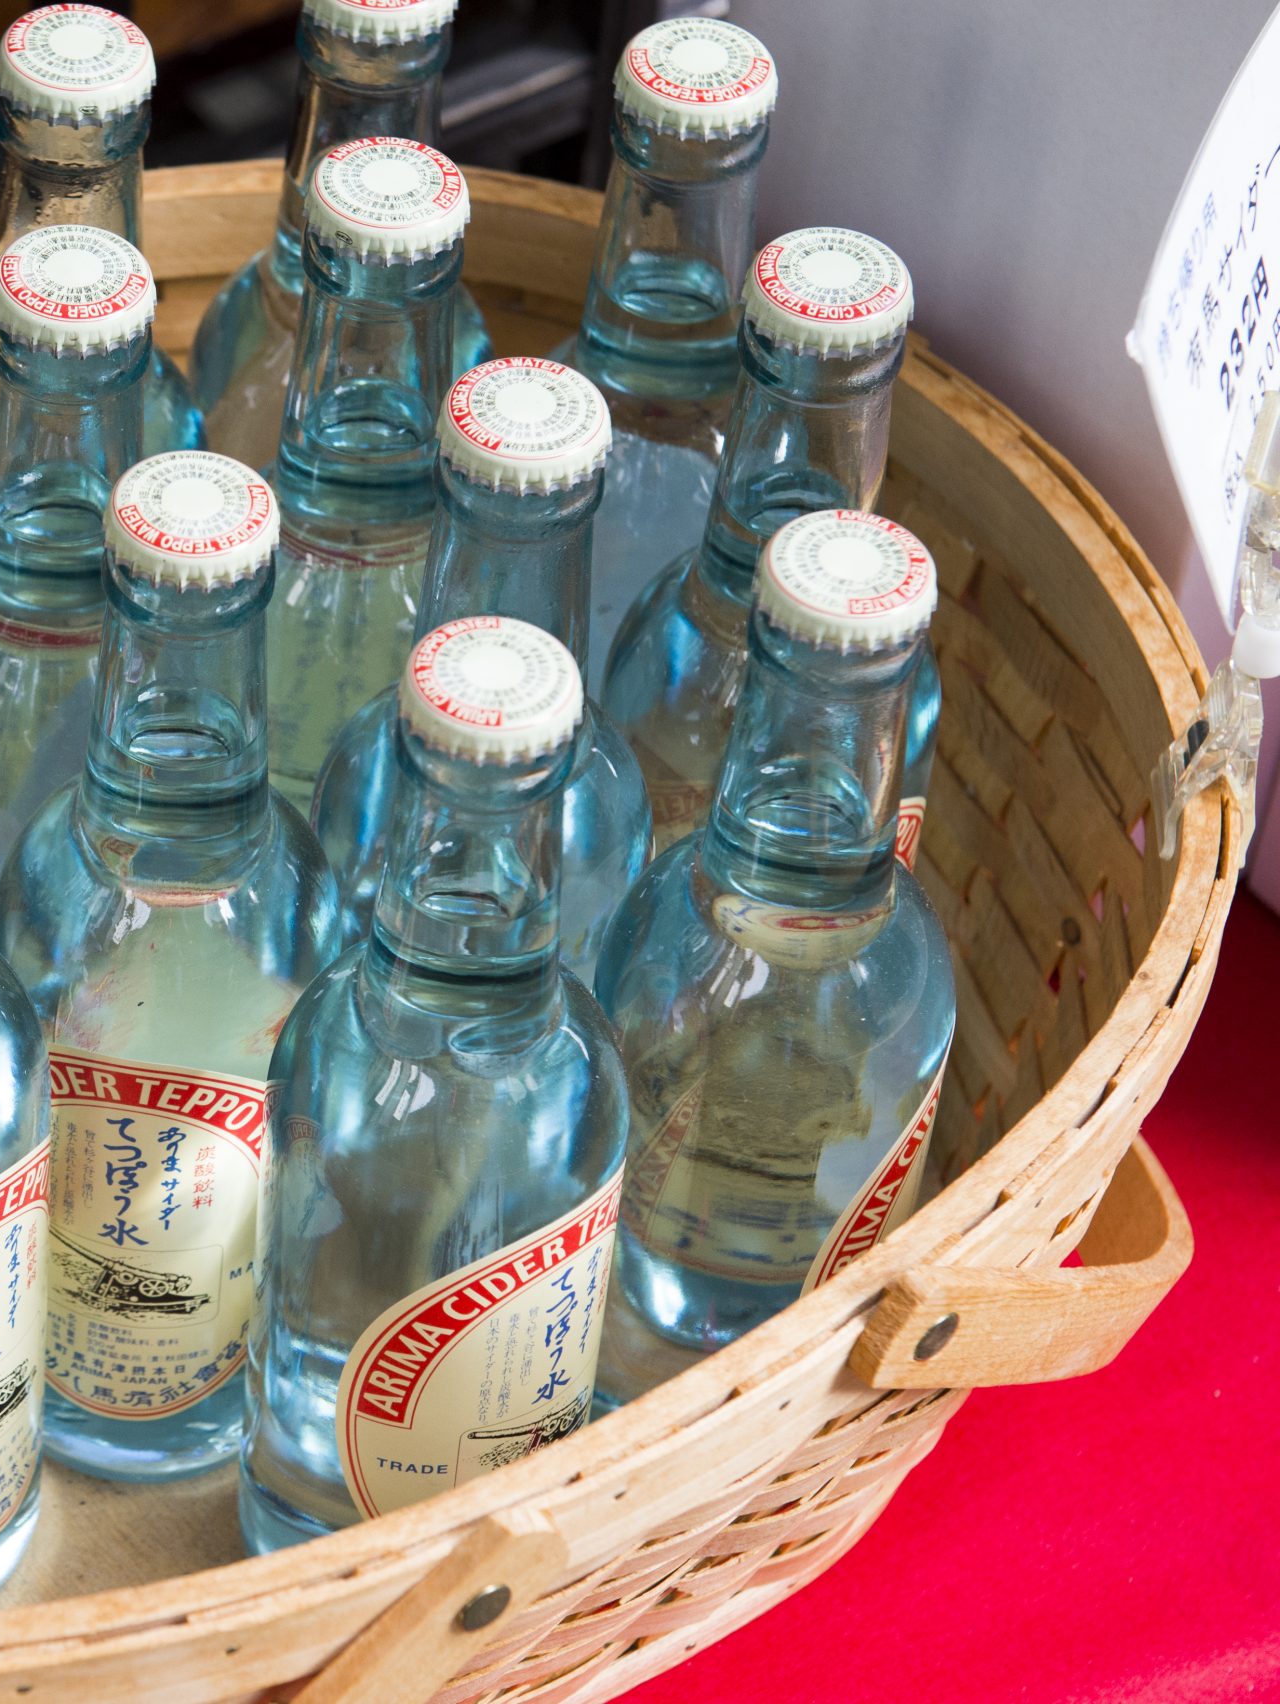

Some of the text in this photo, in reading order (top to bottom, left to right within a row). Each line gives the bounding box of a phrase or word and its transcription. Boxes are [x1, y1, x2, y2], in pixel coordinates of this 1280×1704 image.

[334, 137, 460, 208] ARIMA CIDER TEPPO WATER
[4, 257, 145, 317] ARIMA CIDER TEPPO WATER
[760, 246, 895, 318] ARIMA CIDER TEPPO WATER
[1220, 255, 1269, 411] 232円
[453, 358, 561, 446] ARIMA CIDER TEPPO WATER
[121, 486, 268, 553] ARIMA CIDER TEPPO WATER
[50, 1067, 258, 1130] DER TEPPO
[193, 1146, 216, 1209] 炭酸飲料
[833, 1177, 902, 1275] RIMA
[230, 1263, 254, 1280] MA
[363, 1322, 455, 1416] ARIMA
[443, 1241, 565, 1321] CIDER
[121, 1375, 167, 1385] JAPAN
[376, 1457, 448, 1475] TRADE
